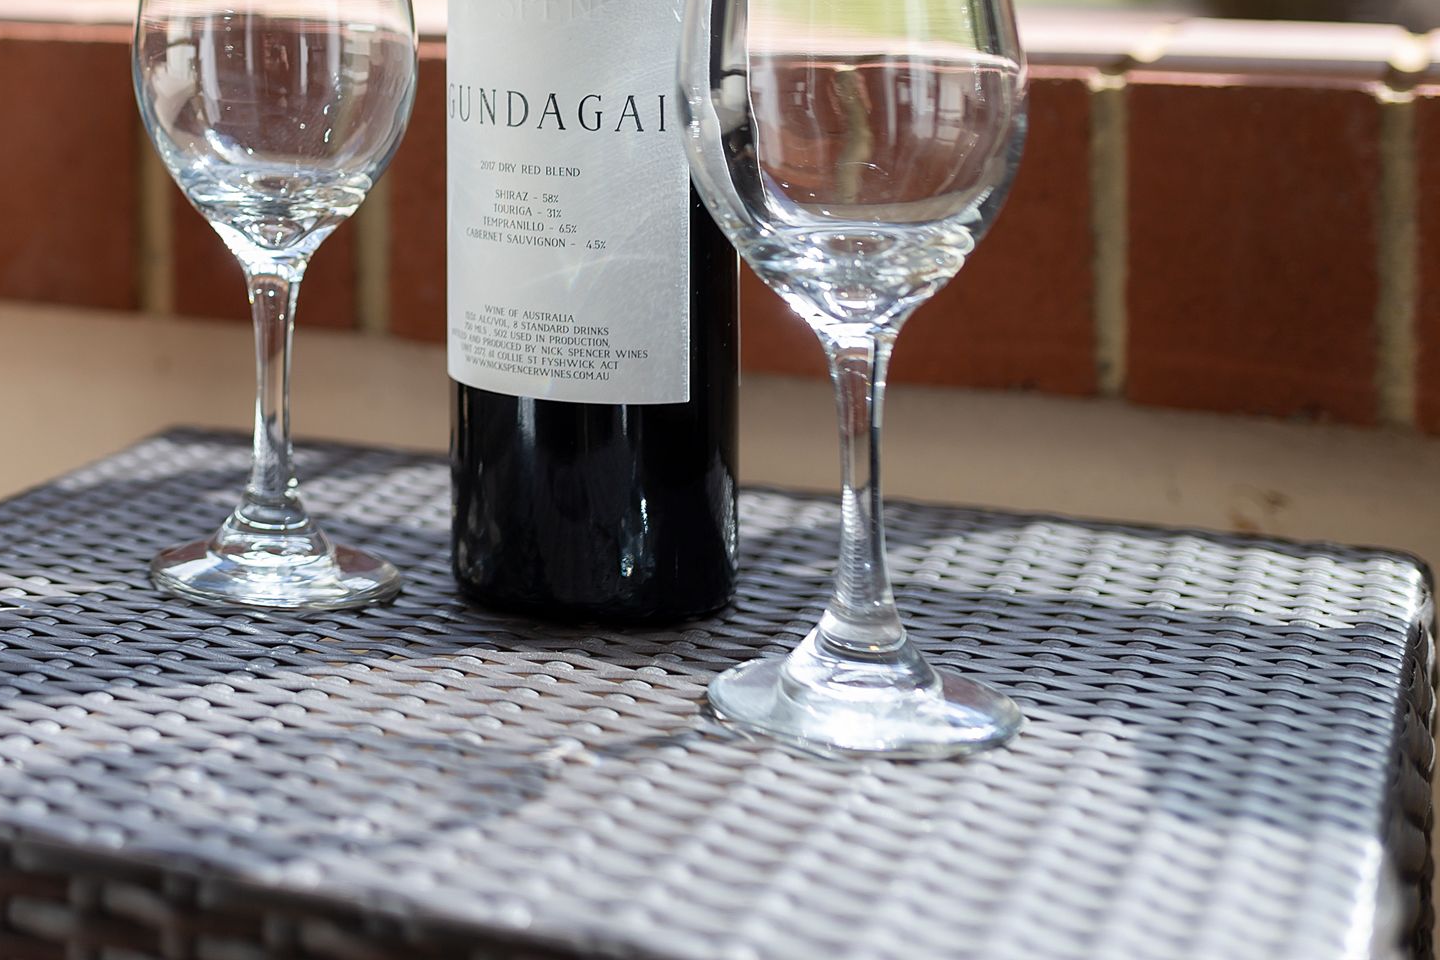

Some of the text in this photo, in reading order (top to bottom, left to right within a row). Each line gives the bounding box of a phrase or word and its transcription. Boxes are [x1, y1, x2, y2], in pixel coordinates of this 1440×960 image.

[449, 83, 666, 132] GUNDAGAI
[480, 160, 581, 177] 2017 DRY RED BLEND
[495, 189, 529, 202] SHIRAZ
[542, 193, 559, 204] 58%
[494, 203, 533, 217] TOURIGA
[546, 208, 562, 219] 31%
[483, 216, 544, 232] TEMPRANILLO
[466, 226, 503, 242] CABERNET
[507, 233, 566, 248] SAUVIGNON
[586, 239, 606, 250] 4.5%
[484, 304, 505, 317] WINE
[508, 309, 518, 318] OF
[522, 310, 575, 323] AUSTRALIA
[513, 320, 518, 329] 8
[520, 321, 570, 334] STANDARD
[573, 325, 609, 336] DRINKS
[510, 331, 532, 342] USED
[536, 333, 545, 343] IN
[482, 336, 522, 351] PRODUCED
[524, 343, 537, 353] BY
[541, 345, 563, 356] NICK
[567, 347, 611, 359] SPENCER
[615, 349, 649, 359] WINES
[497, 351, 523, 363] COLLIE
[527, 355, 537, 365] ST
[541, 356, 595, 369] FYSHWICK
[600, 360, 619, 370] ACT
